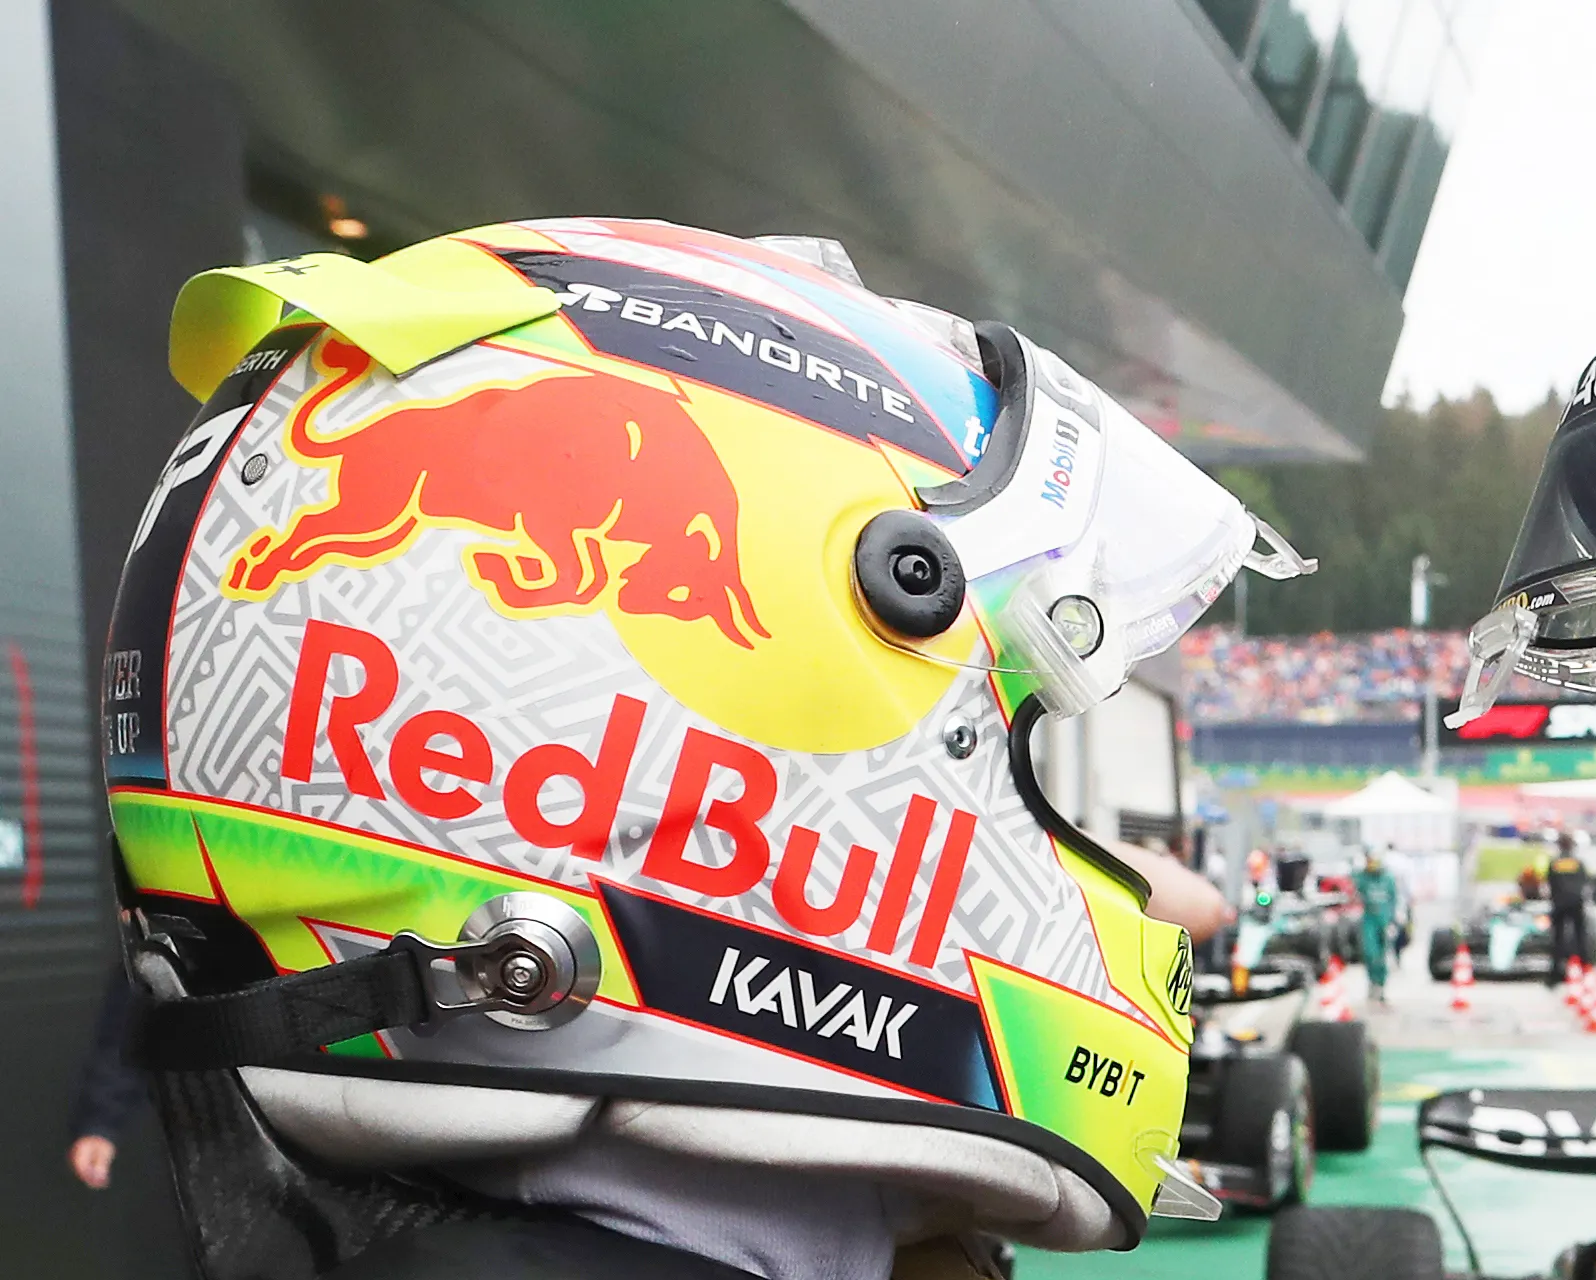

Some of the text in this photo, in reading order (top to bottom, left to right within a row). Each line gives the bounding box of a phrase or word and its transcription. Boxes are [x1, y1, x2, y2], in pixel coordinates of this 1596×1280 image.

[620, 300, 915, 424] BANORTE
[1040, 439, 1077, 510] Mobil
[281, 617, 977, 968] Red Bull
[709, 947, 918, 1059] KAVAK
[1064, 1046, 1145, 1106] BYBIT
